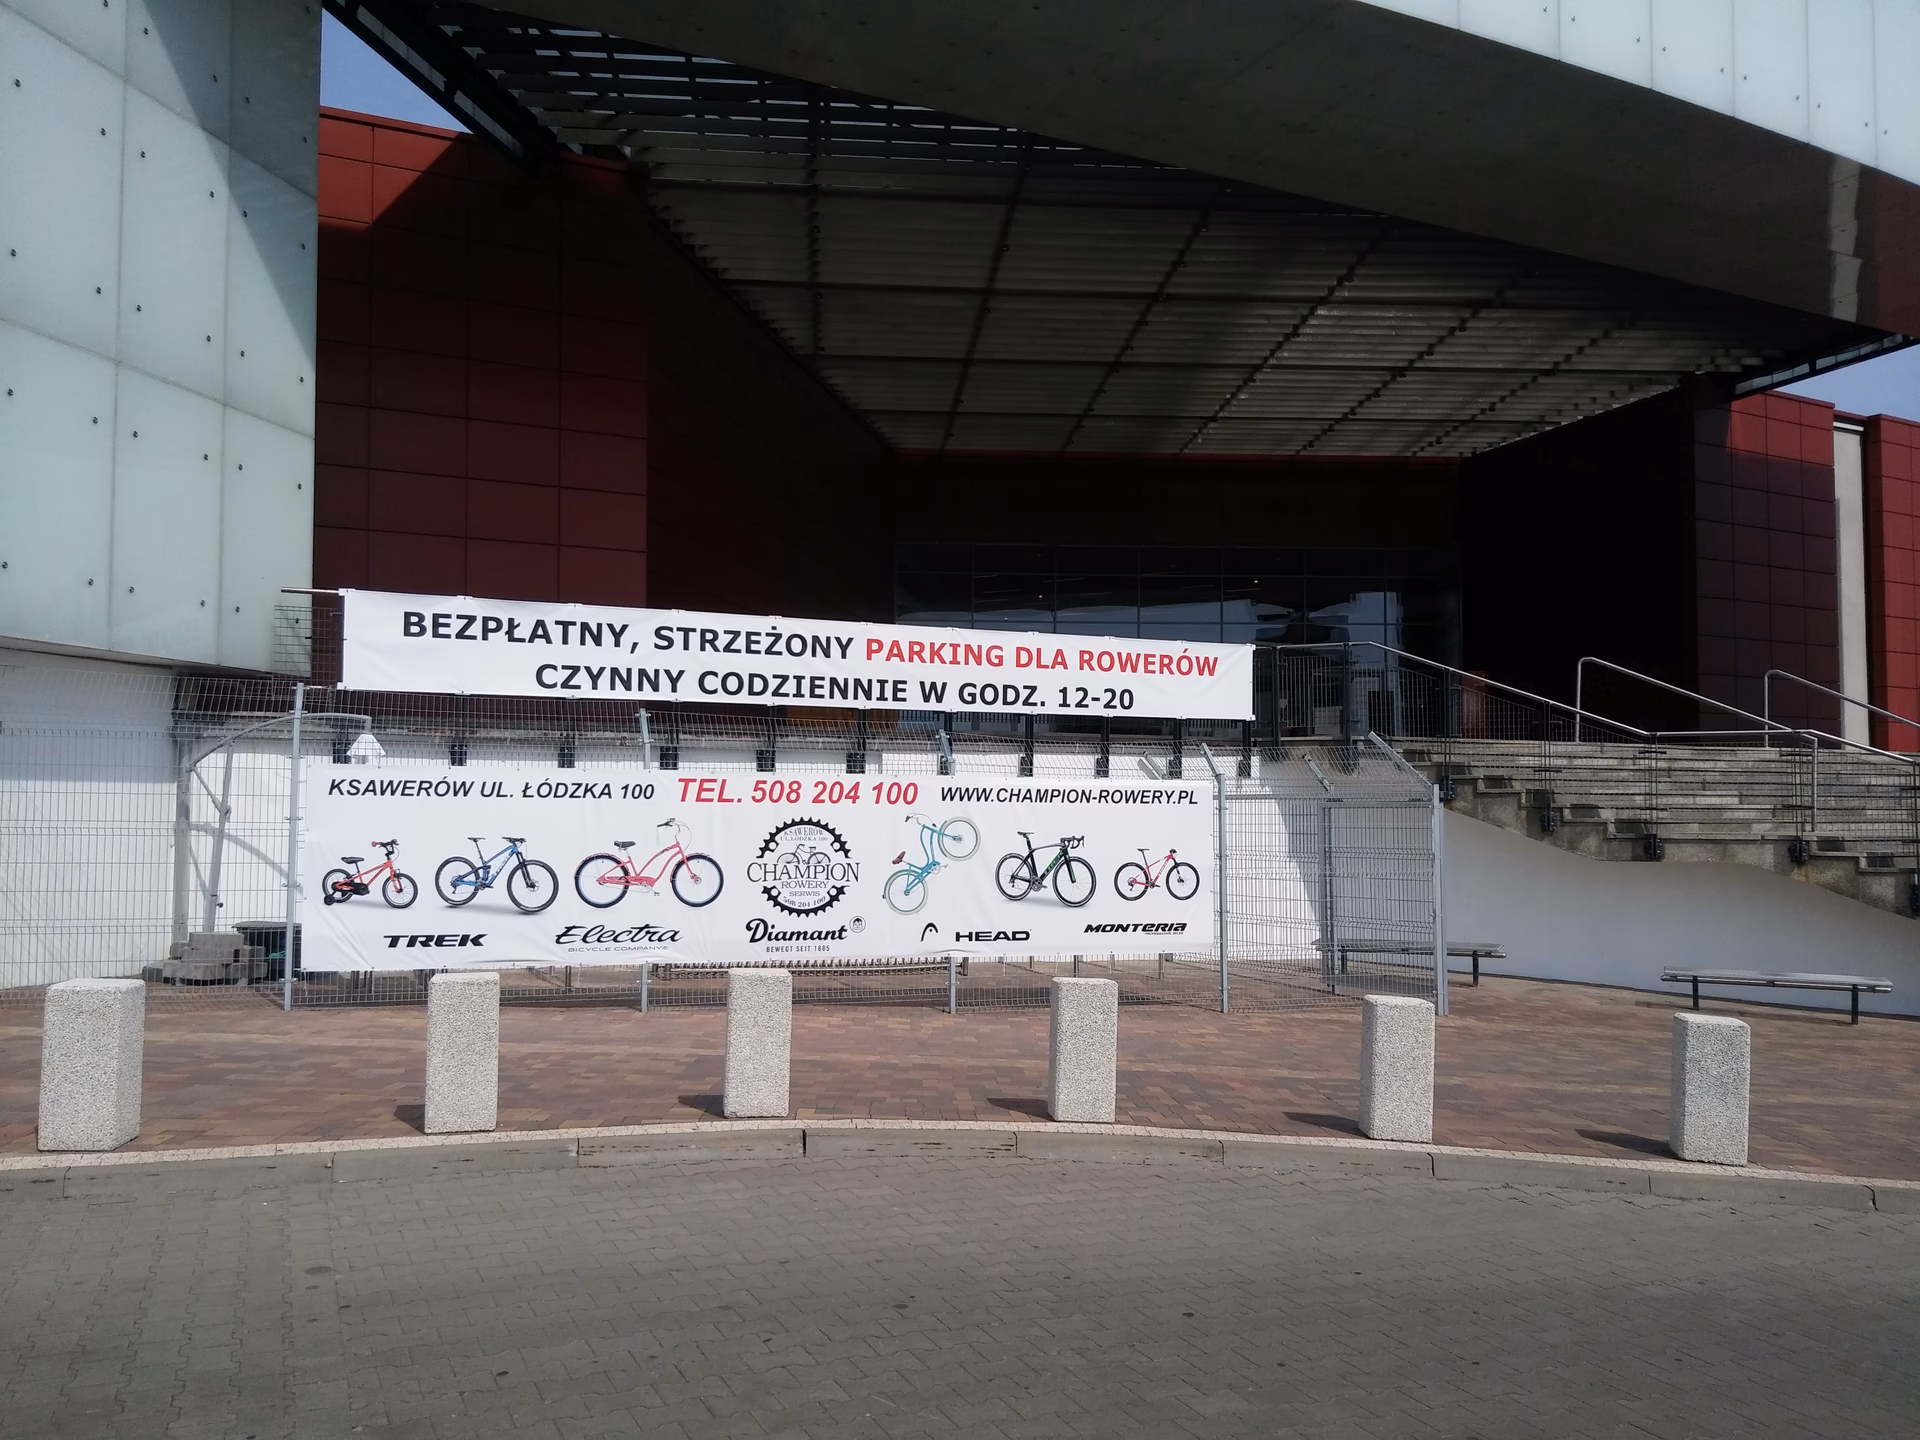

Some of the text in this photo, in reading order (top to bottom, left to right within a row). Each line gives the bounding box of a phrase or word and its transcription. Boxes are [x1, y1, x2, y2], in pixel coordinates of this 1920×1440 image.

[403, 610, 1219, 677] BEZPŁATNY, STRZEŻONY PARKING DLA ROWERÓW
[535, 663, 1134, 711] CZYNNY CODZIENNIE W GODZ. 12-20
[327, 776, 655, 800] KSAWERÓW UL. ŁÓDZKA 100
[677, 777, 919, 806] TEL. 508 204 100
[940, 786, 1199, 805] WWW.CHAMPION-ROWERY.PL
[746, 862, 861, 883] CHAMPION
[781, 880, 830, 889] ROWERY
[382, 933, 489, 949] TREK
[555, 923, 684, 945] Electra
[745, 917, 848, 944] Diamant
[955, 930, 1031, 943] HEAD
[765, 945, 794, 953] BEWEGT
